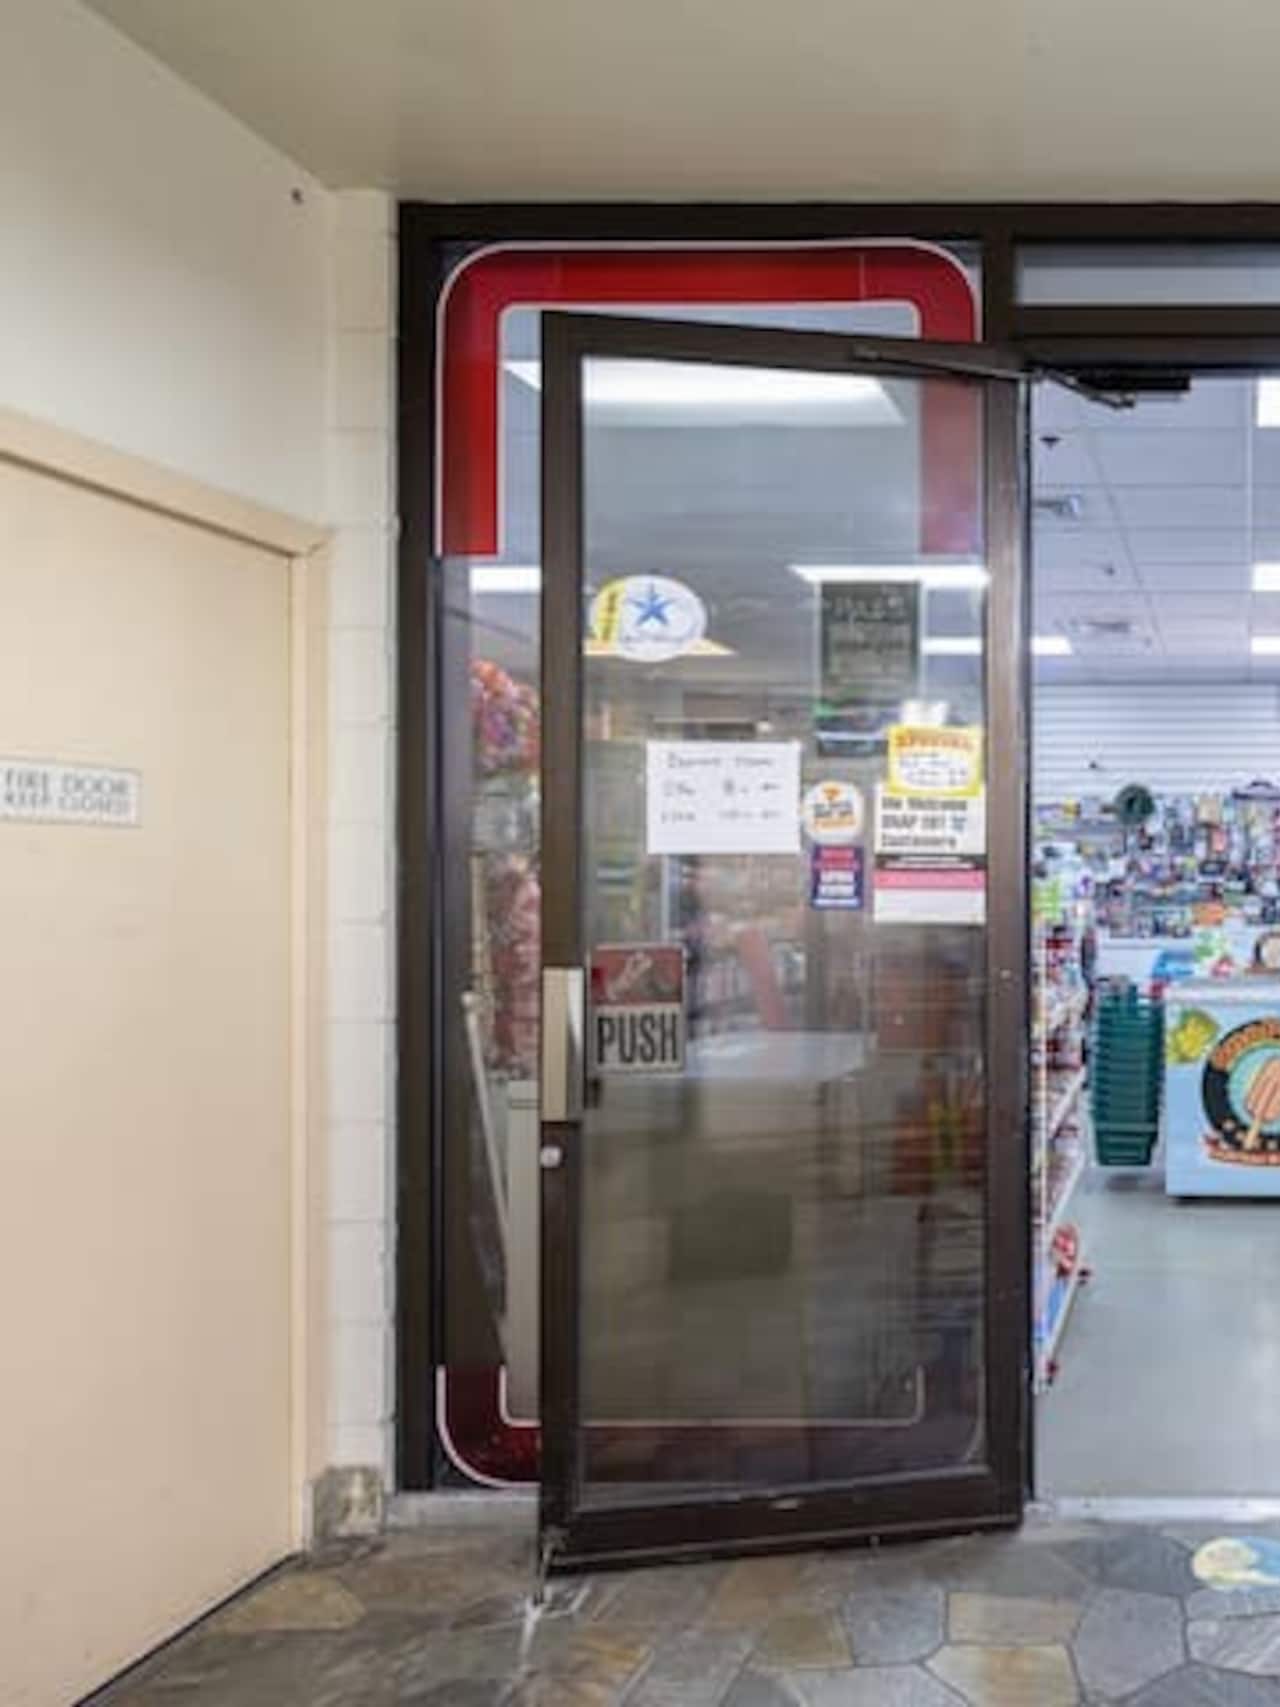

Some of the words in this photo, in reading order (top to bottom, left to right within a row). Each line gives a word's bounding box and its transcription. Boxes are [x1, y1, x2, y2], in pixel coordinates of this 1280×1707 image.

[5, 767, 50, 789] FIRE
[62, 773, 129, 796] DOOR
[597, 1012, 679, 1064] PUSH
